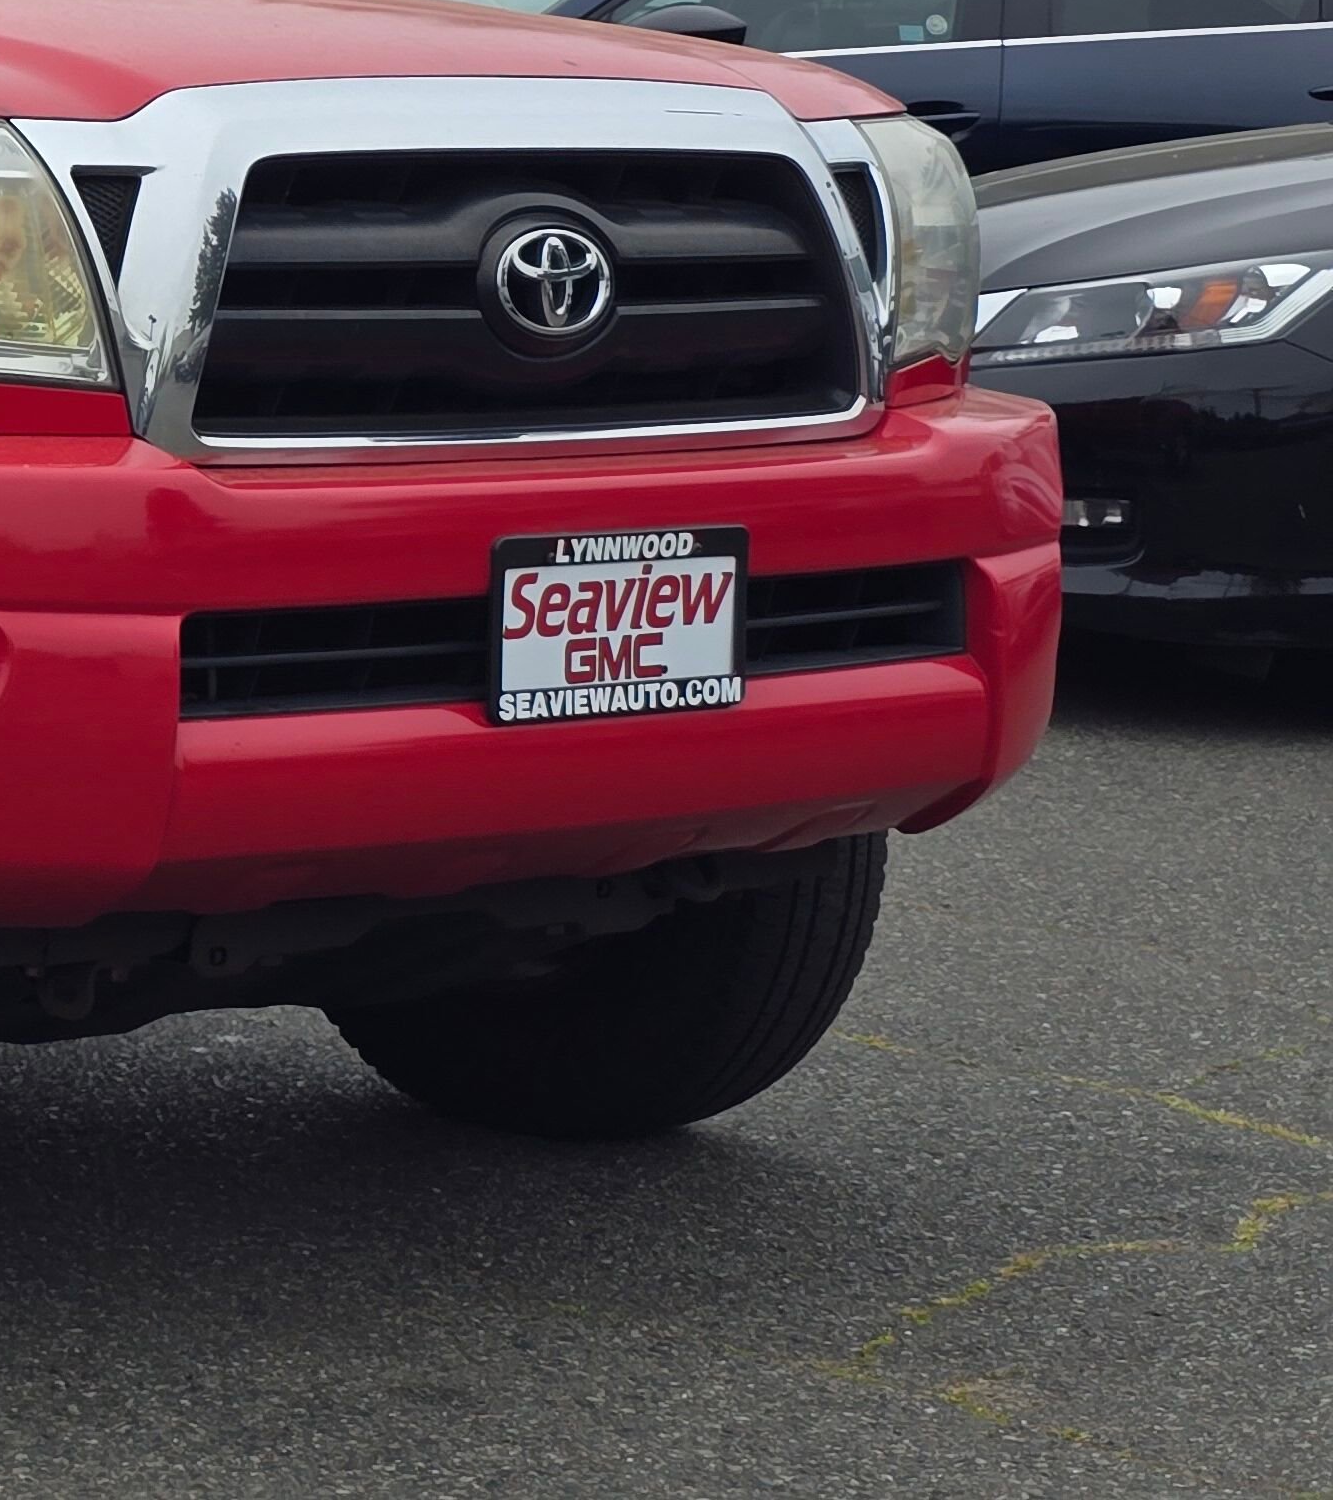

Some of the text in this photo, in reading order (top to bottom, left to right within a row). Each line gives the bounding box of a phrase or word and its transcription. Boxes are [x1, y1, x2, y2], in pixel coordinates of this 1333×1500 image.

[555, 532, 694, 564] LYNNWOOD
[502, 563, 734, 640] Seaview
[564, 632, 664, 684] GMC
[498, 676, 742, 722] SEAVIEWAUTO.COM
